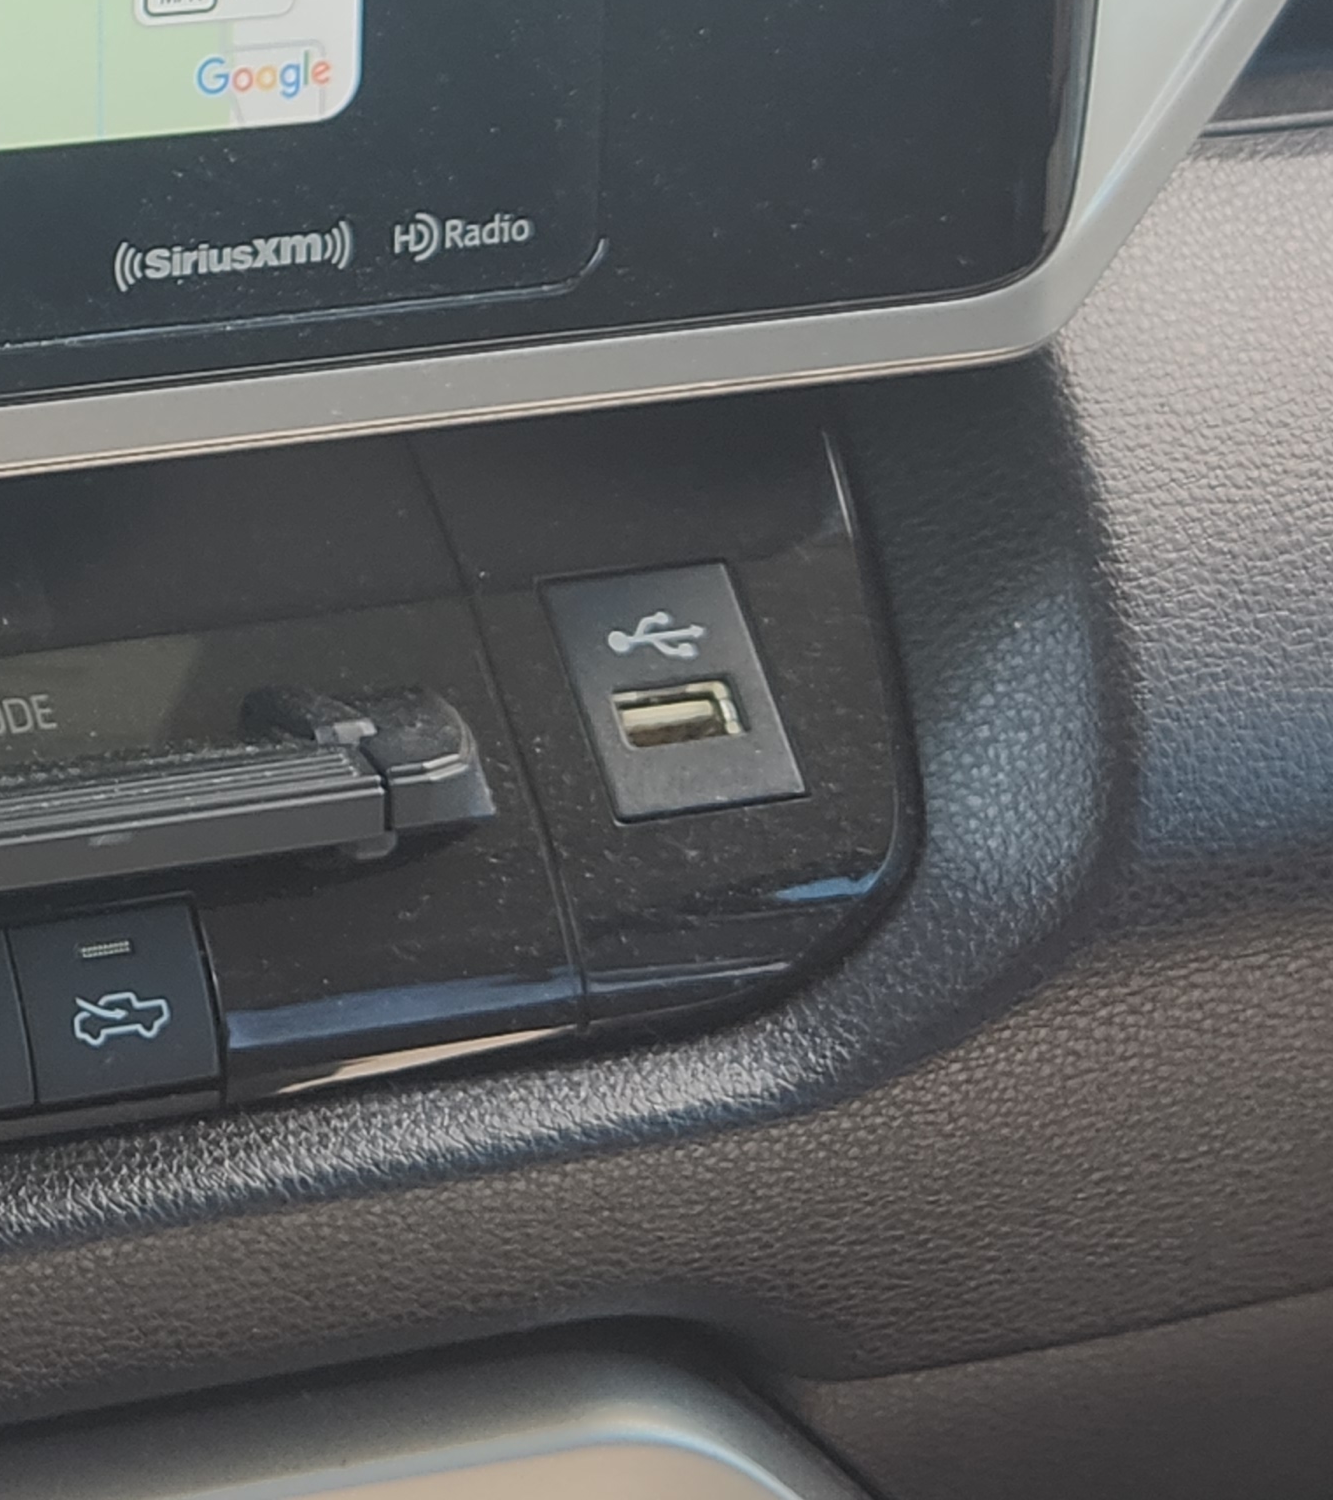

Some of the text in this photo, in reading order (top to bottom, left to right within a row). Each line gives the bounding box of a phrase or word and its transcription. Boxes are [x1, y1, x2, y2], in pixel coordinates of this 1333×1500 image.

[196, 50, 331, 98] Google
[394, 213, 530, 261] HD Radio
